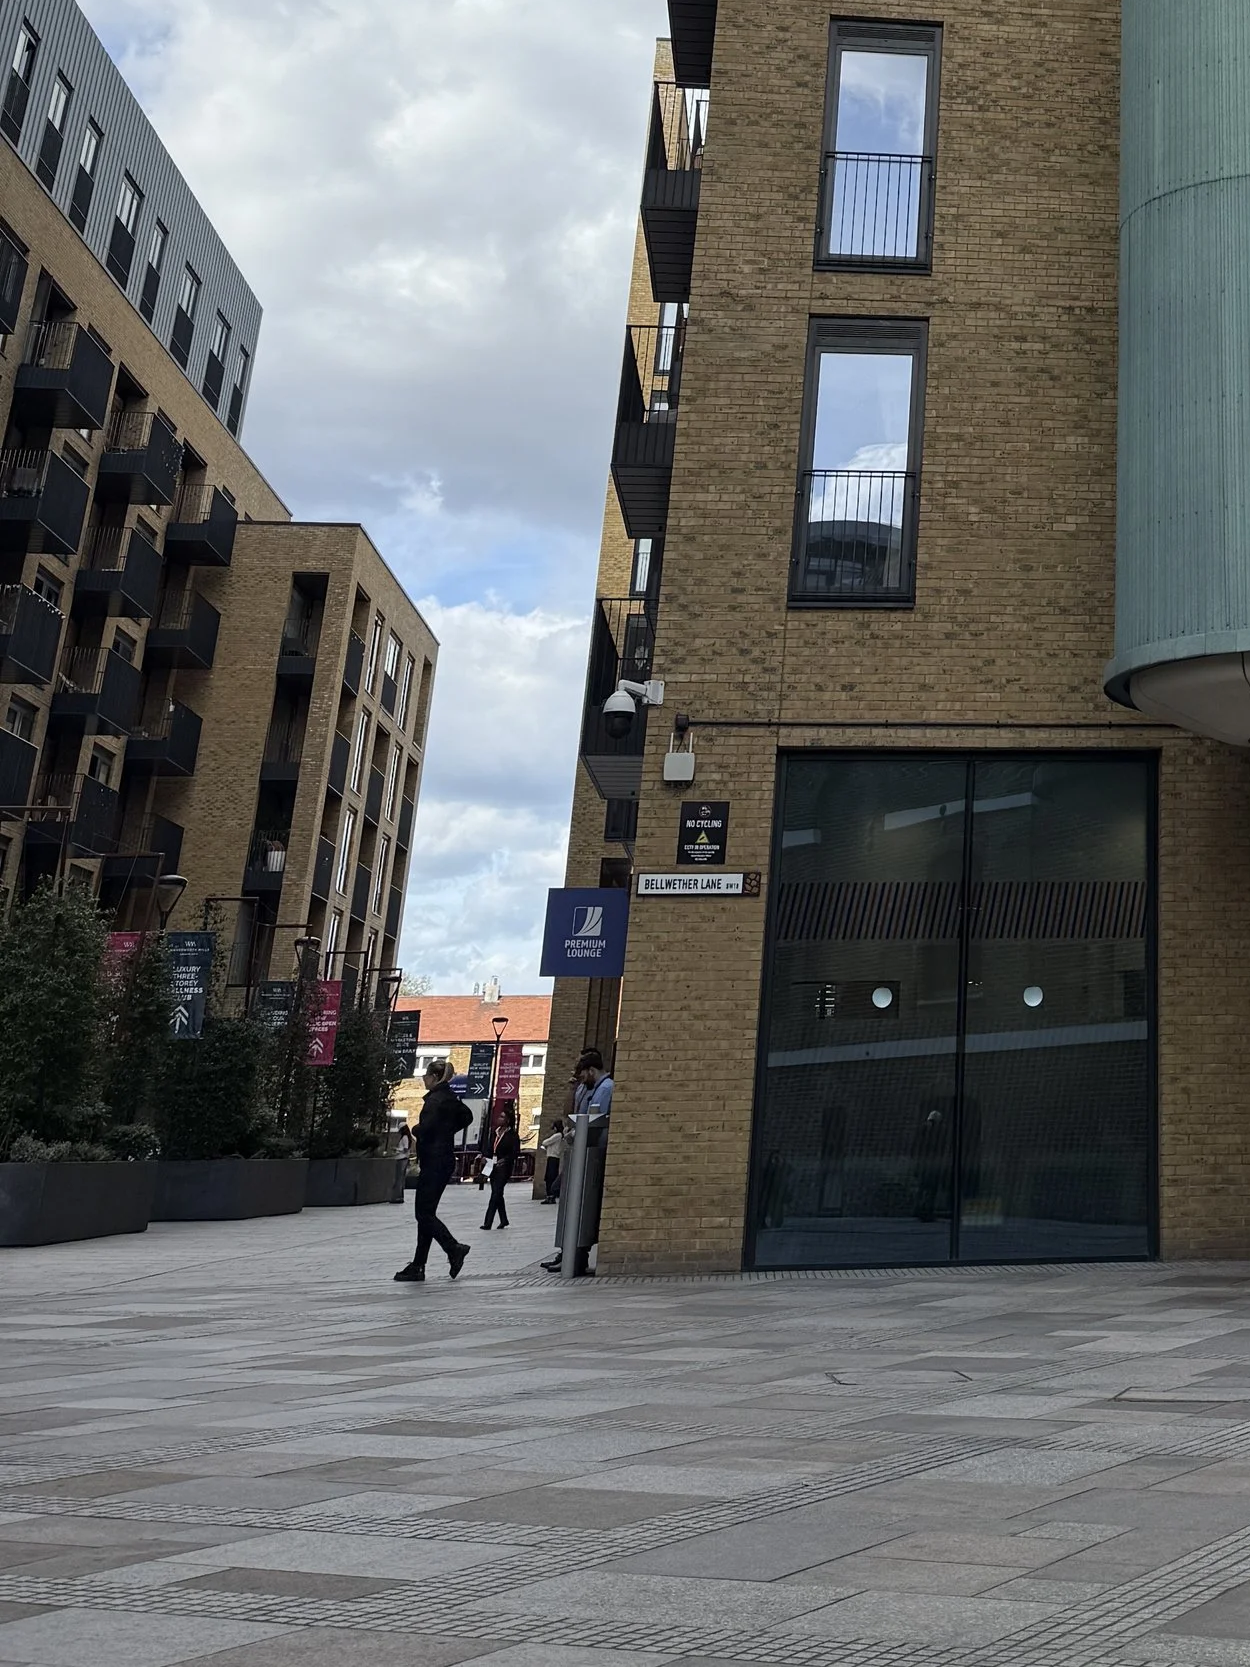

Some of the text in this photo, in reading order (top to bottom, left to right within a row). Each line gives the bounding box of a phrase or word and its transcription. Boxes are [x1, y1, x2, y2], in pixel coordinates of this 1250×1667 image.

[686, 819, 722, 828] NO CYCLING
[644, 878, 699, 890] BELLWETHER
[701, 878, 722, 890] LANE
[564, 939, 606, 948] PREMIUM
[567, 948, 602, 958] LOUNGE
